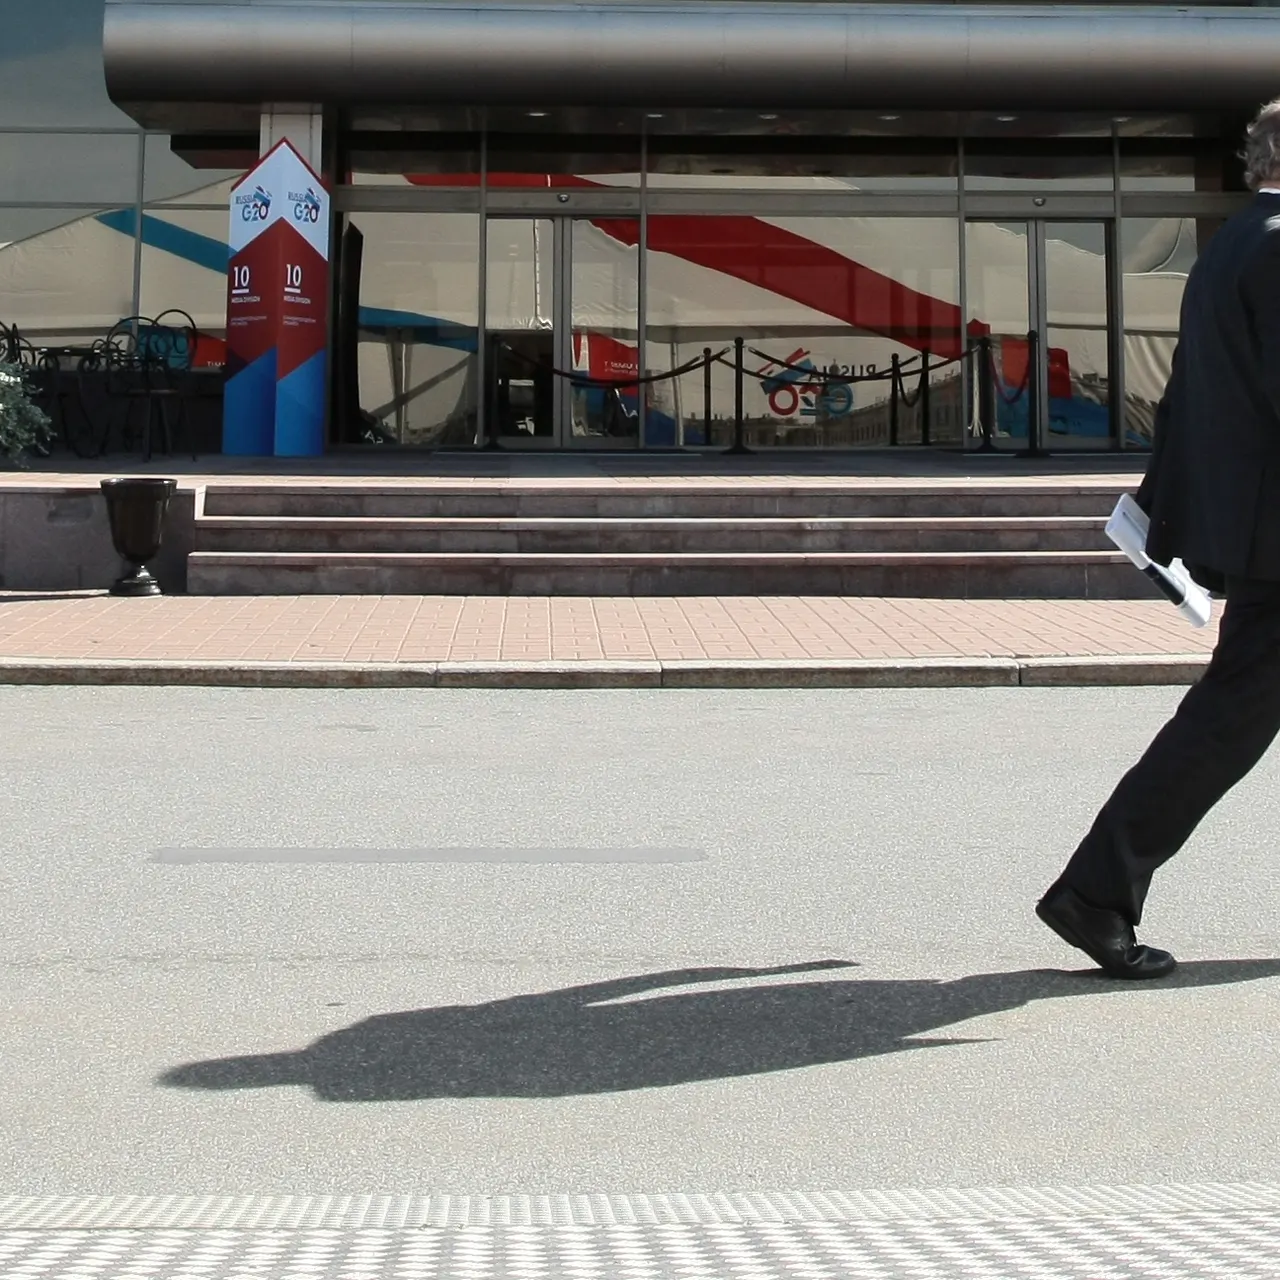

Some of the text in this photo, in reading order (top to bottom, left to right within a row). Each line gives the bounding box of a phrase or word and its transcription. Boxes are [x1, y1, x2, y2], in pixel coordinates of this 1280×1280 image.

[242, 202, 269, 222] G20
[294, 202, 319, 223] G20
[233, 265, 250, 287] 10
[286, 263, 302, 287] 10
